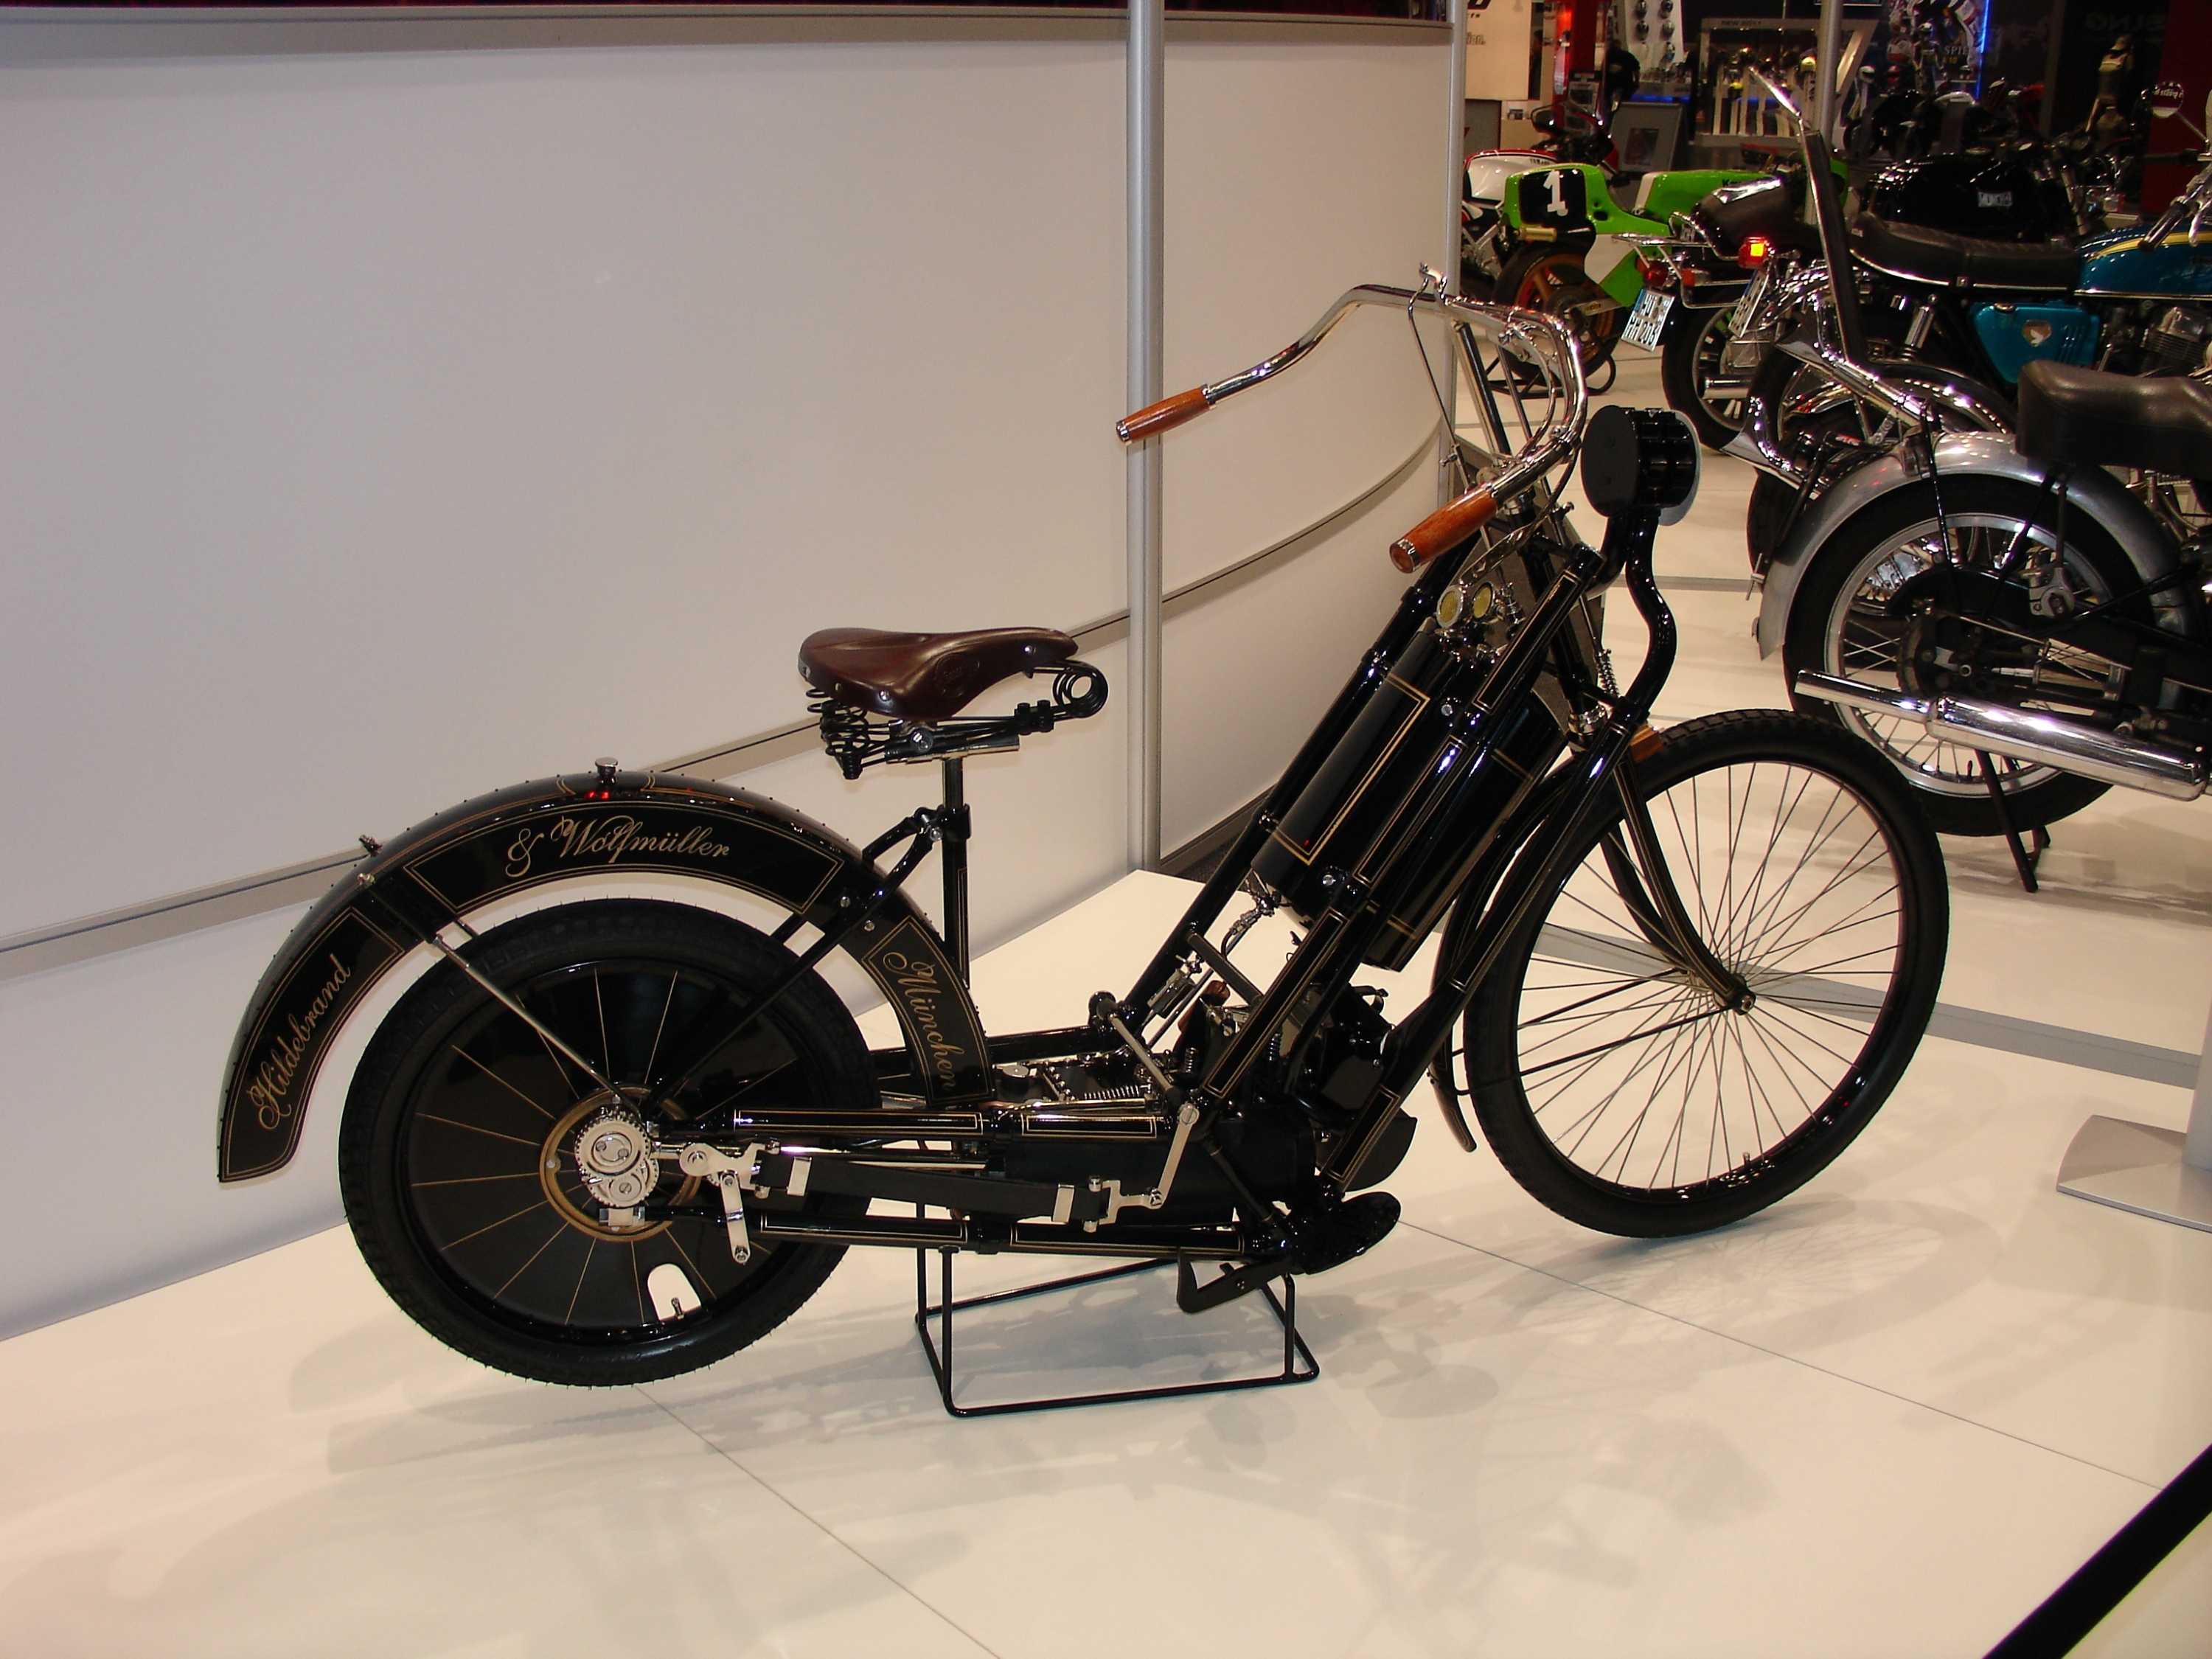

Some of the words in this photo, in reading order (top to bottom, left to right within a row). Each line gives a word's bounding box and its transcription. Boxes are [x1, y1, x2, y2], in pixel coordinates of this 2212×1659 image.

[1543, 170, 1565, 212] 1
[246, 953, 351, 1130] Hildebrand
[505, 828, 545, 877] &
[550, 815, 730, 863] Wolfmüller
[883, 951, 965, 1091] München
